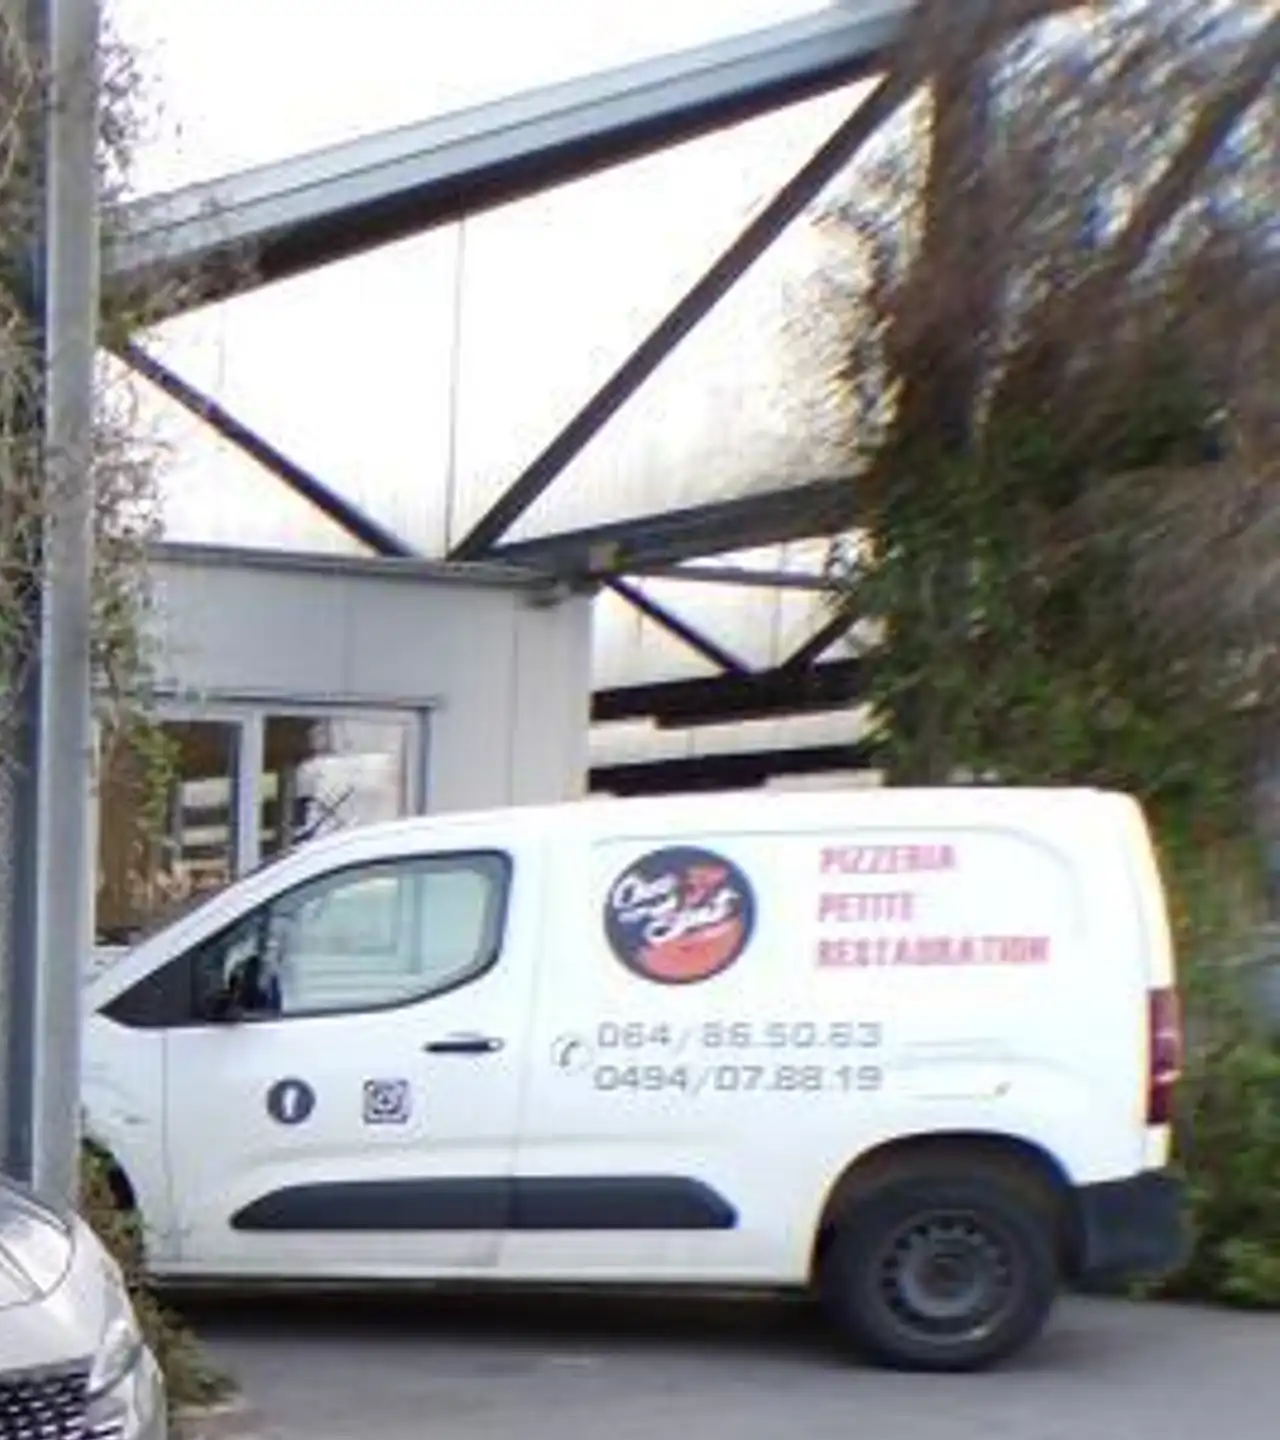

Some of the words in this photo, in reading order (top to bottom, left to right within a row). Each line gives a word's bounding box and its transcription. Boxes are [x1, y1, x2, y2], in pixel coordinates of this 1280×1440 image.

[818, 844, 957, 875] PIZZERIA
[816, 889, 915, 922] PETITE
[815, 935, 1052, 967] RESTAURATION
